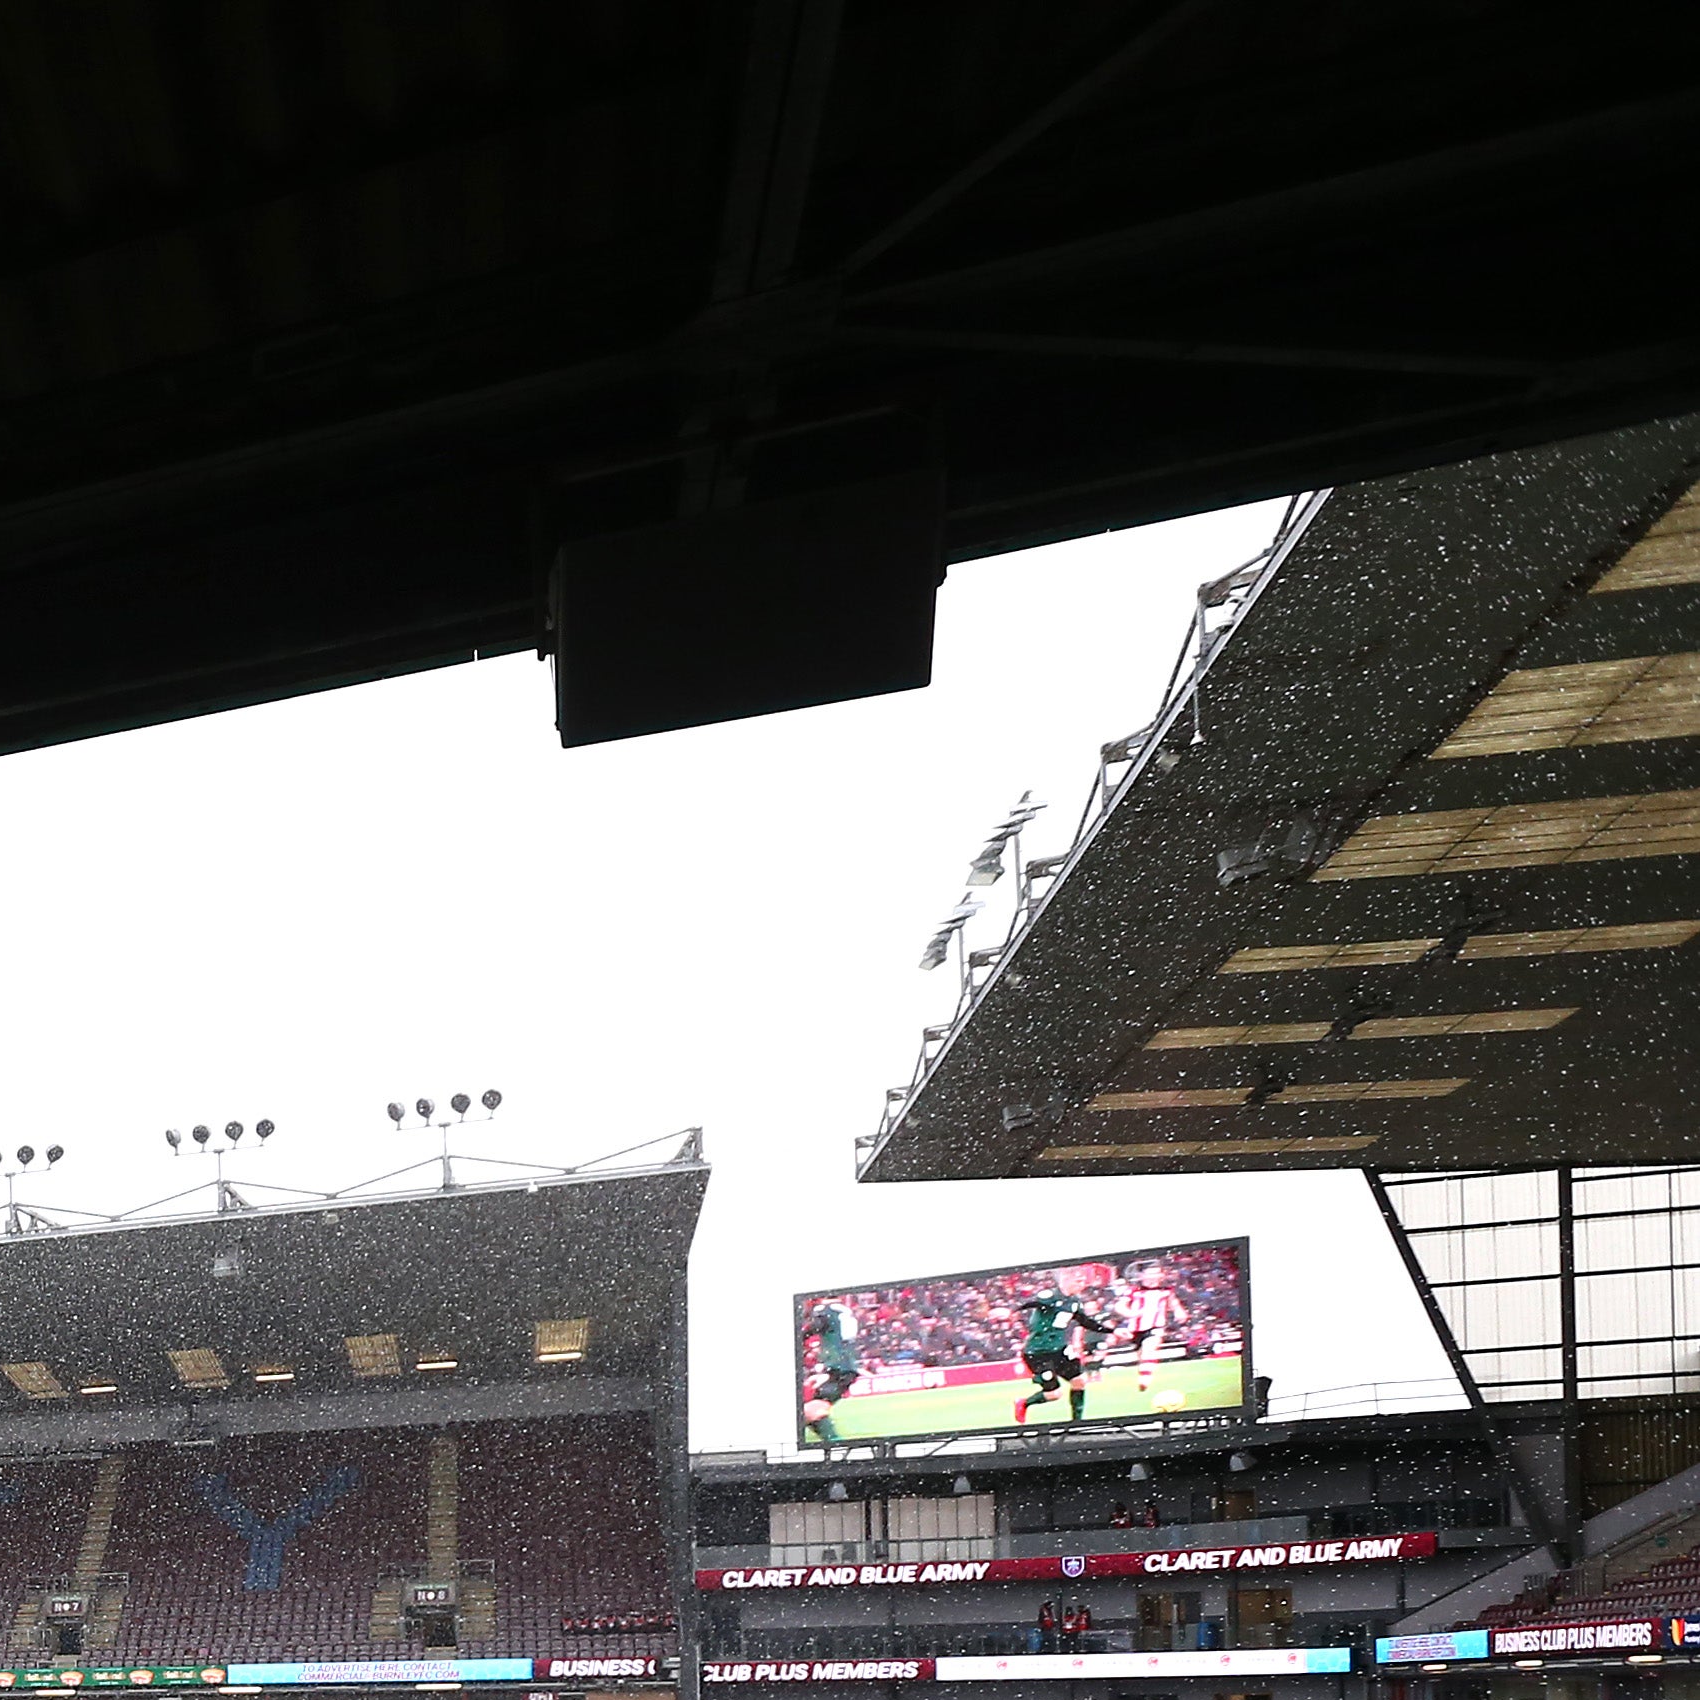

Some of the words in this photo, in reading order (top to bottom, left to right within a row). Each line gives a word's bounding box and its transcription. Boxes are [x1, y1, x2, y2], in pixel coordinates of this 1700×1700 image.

[1144, 1549, 1234, 1573] CLARET
[1237, 1546, 1286, 1568] AND
[1289, 1542, 1342, 1564] BLUE
[1344, 1538, 1404, 1561] ARMY
[722, 1568, 807, 1589] CLARET
[808, 1566, 857, 1587] AND
[860, 1564, 917, 1585] BLUE
[918, 1562, 990, 1583] ARMY
[1494, 1630, 1541, 1653] BUSINESS
[1540, 1627, 1567, 1651] CLUB
[1567, 1625, 1596, 1649] PLUS
[1596, 1622, 1653, 1647] MEMBERS
[316, 1664, 371, 1673] ADVERTISE
[402, 1662, 452, 1671] CONTACT
[548, 1659, 644, 1678] BUSINESS
[754, 1663, 808, 1680] PLUS
[812, 1661, 919, 1680] MEMBERS
